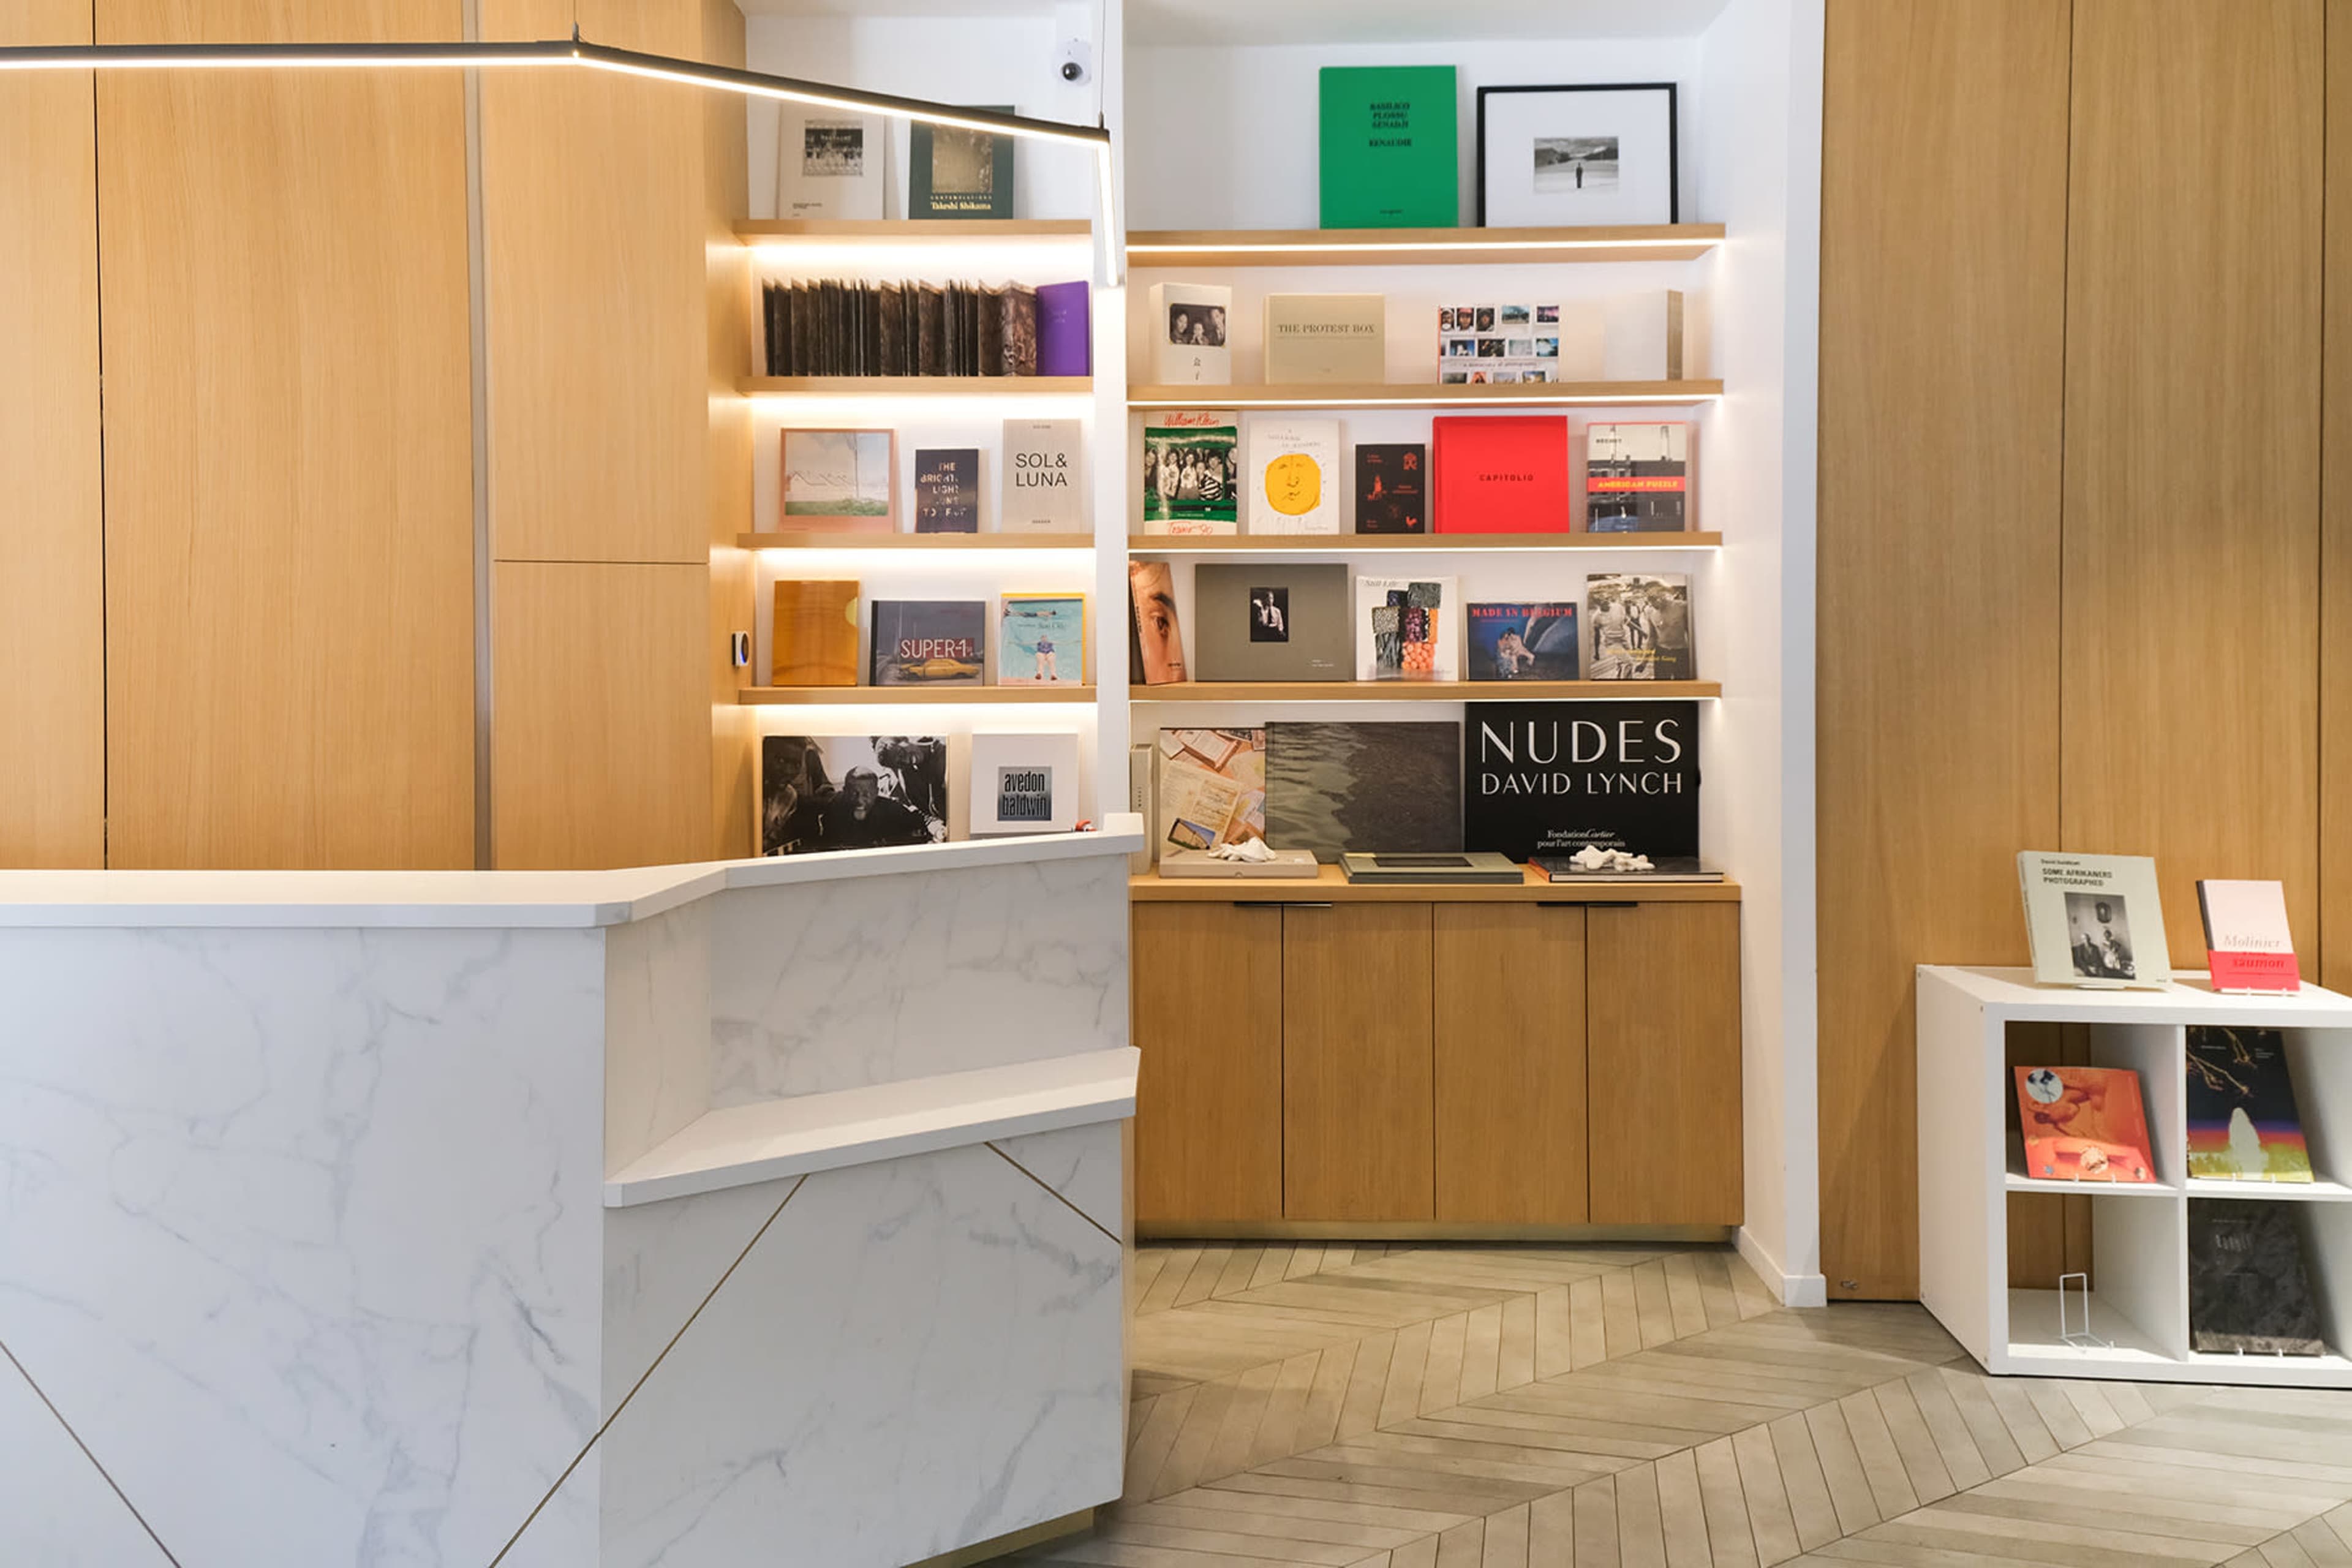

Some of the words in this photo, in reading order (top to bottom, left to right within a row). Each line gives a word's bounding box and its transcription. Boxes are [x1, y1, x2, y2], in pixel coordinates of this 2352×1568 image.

[1278, 323, 1299, 333] THE
[1303, 323, 1349, 333] PROTEST
[1352, 323, 1374, 333] BOX
[1016, 453, 1067, 468] SOL&
[1016, 472, 1067, 486] LUNA
[1472, 608, 1501, 617] MADE
[1506, 608, 1518, 617] IN
[1521, 608, 1572, 618] BELGIUM
[1481, 719, 1681, 764] NUDES
[1005, 771, 1044, 792] avedon
[1482, 772, 1571, 794] DAVID
[1587, 772, 1681, 794] LYNCH
[1003, 794, 1046, 816] baldwin
[1537, 841, 1556, 850] pour
[2066, 870, 2112, 878] AFRIKANERS
[2225, 935, 2280, 948] Molinier
